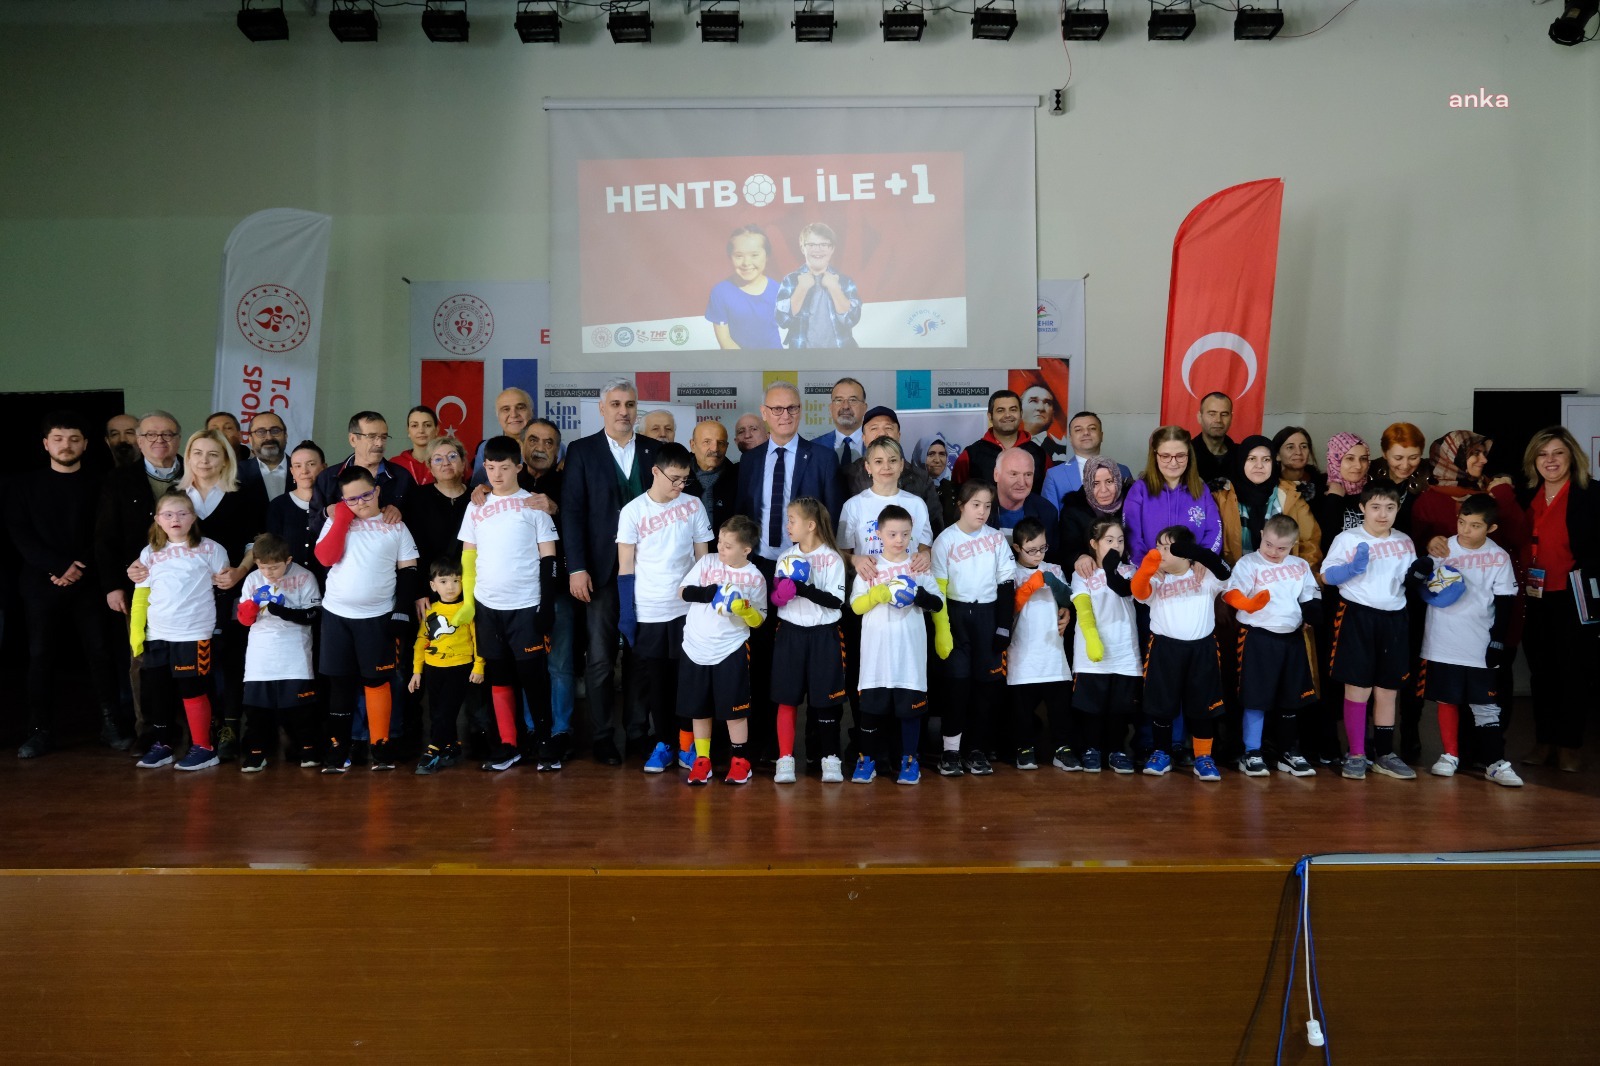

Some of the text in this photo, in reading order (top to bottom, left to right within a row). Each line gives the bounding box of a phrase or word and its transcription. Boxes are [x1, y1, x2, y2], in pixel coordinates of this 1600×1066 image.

[816, 168, 876, 202] İLE
[884, 164, 936, 204] +1
[952, 388, 987, 396] YARIŞMASI
[546, 401, 577, 415] kim
[470, 498, 530, 527] Kemp
